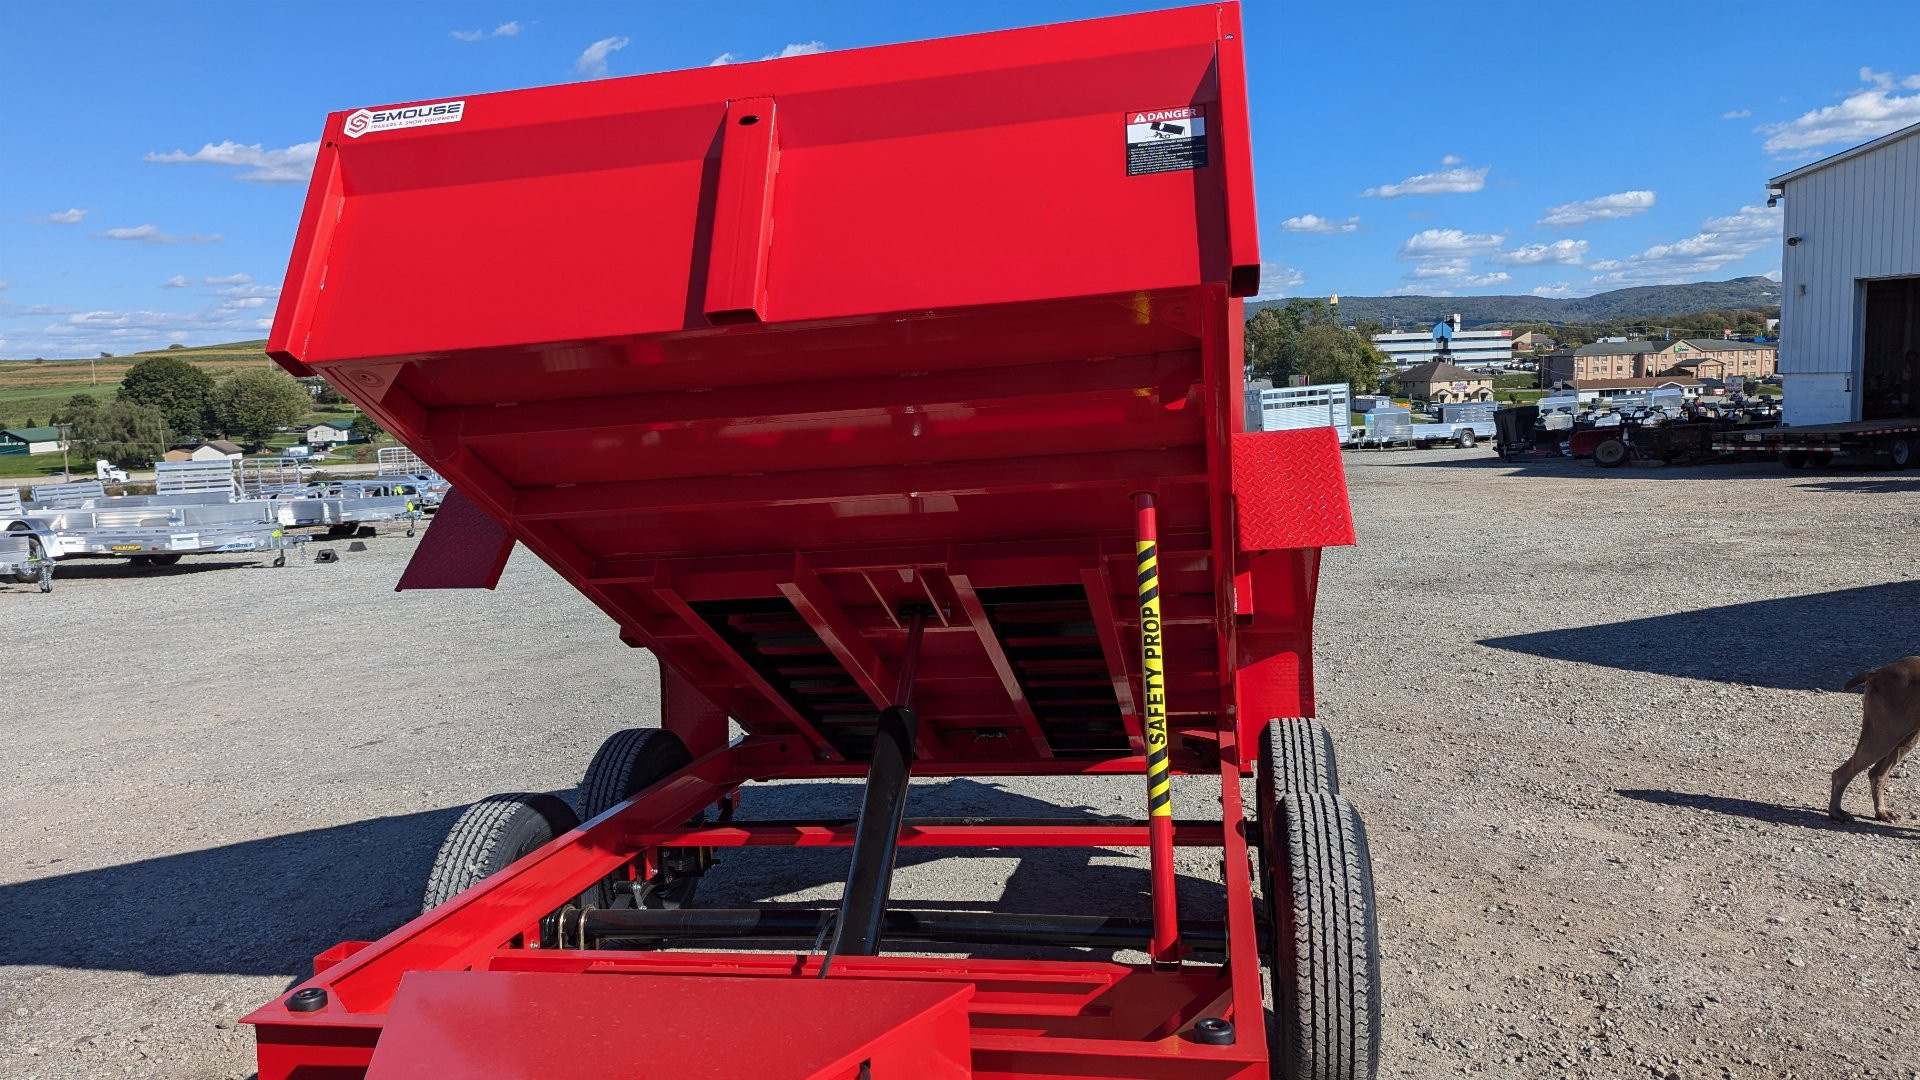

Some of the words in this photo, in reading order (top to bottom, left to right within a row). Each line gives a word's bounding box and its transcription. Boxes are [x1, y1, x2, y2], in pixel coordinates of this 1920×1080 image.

[372, 104, 461, 123] SMOUSE
[1148, 109, 1196, 121] DANGER
[1142, 606, 1161, 659] PROP
[1145, 667, 1165, 745] SAFETY
